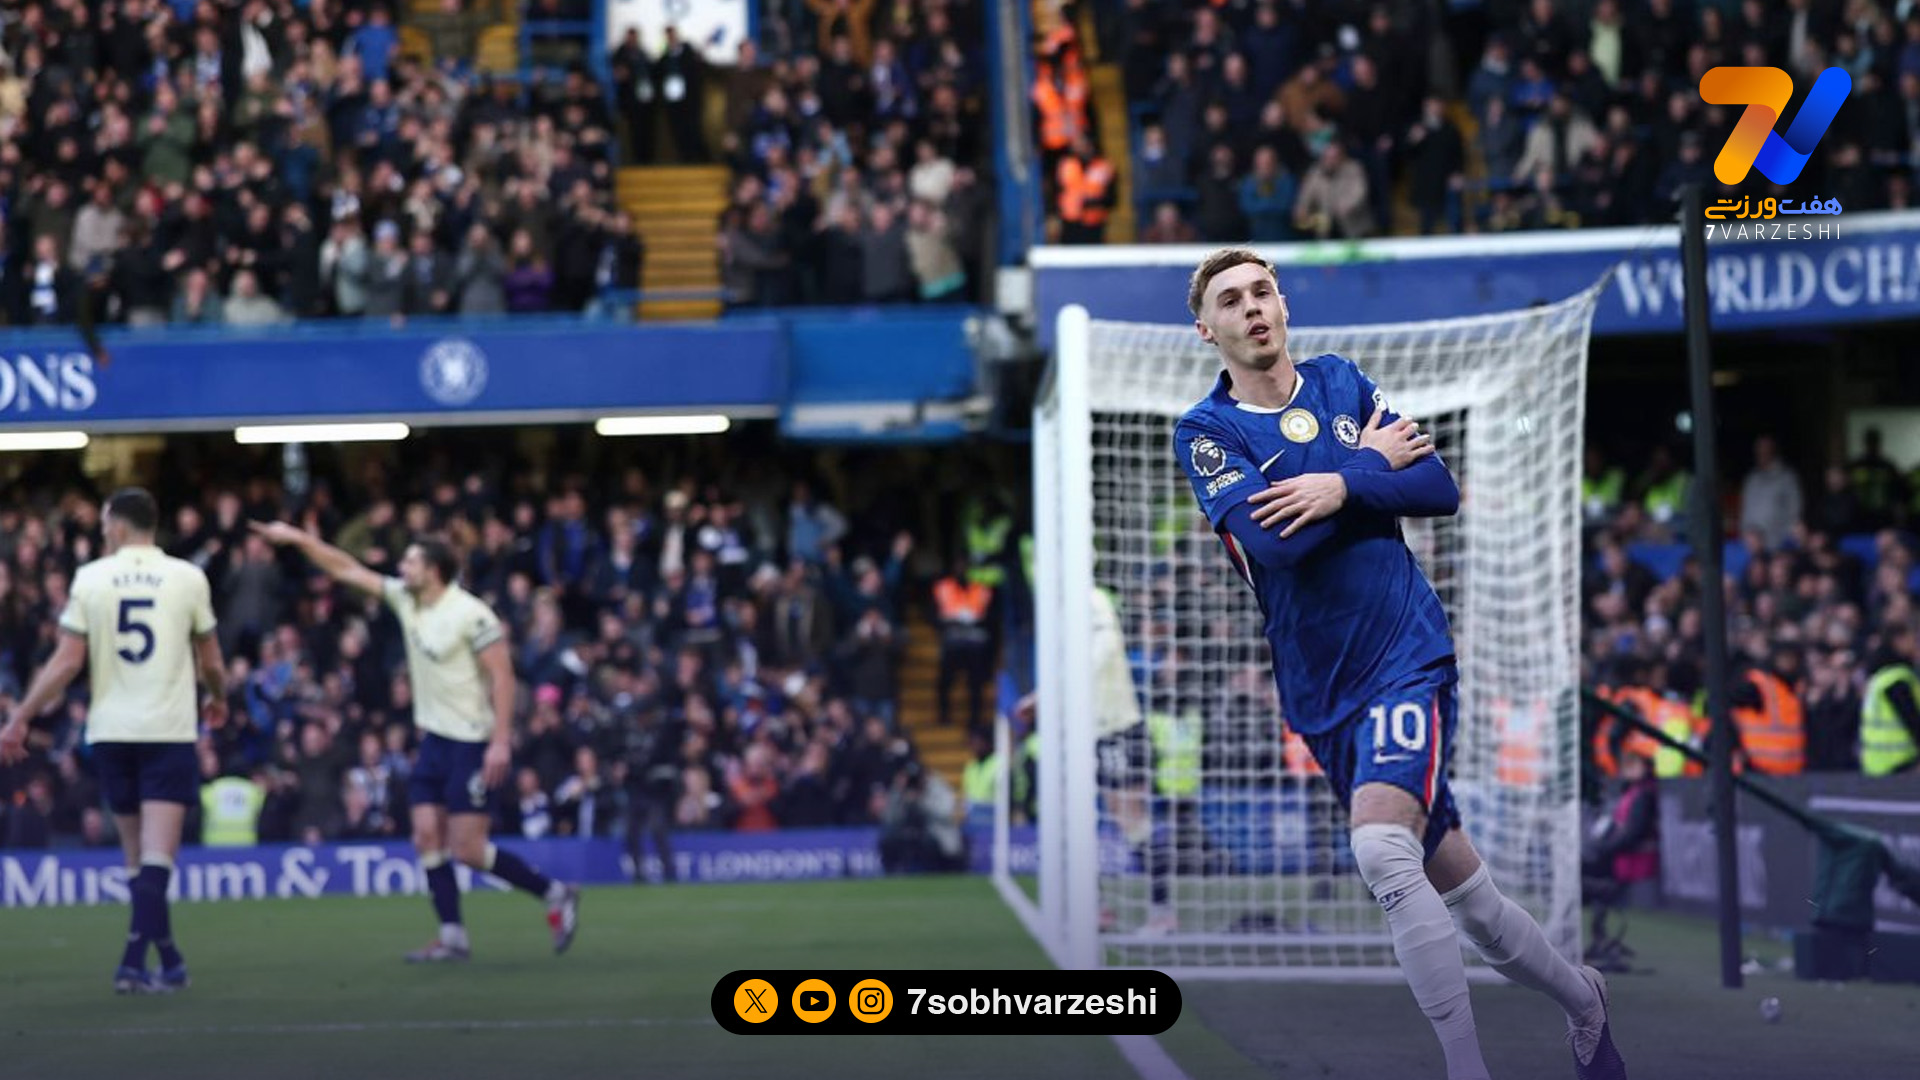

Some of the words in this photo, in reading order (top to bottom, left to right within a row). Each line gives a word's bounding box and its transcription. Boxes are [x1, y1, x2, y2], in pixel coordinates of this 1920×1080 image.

[117, 598, 156, 664] 5
[1370, 703, 1427, 751] 10
[2, 854, 266, 907] Musum
[276, 847, 331, 899] &
